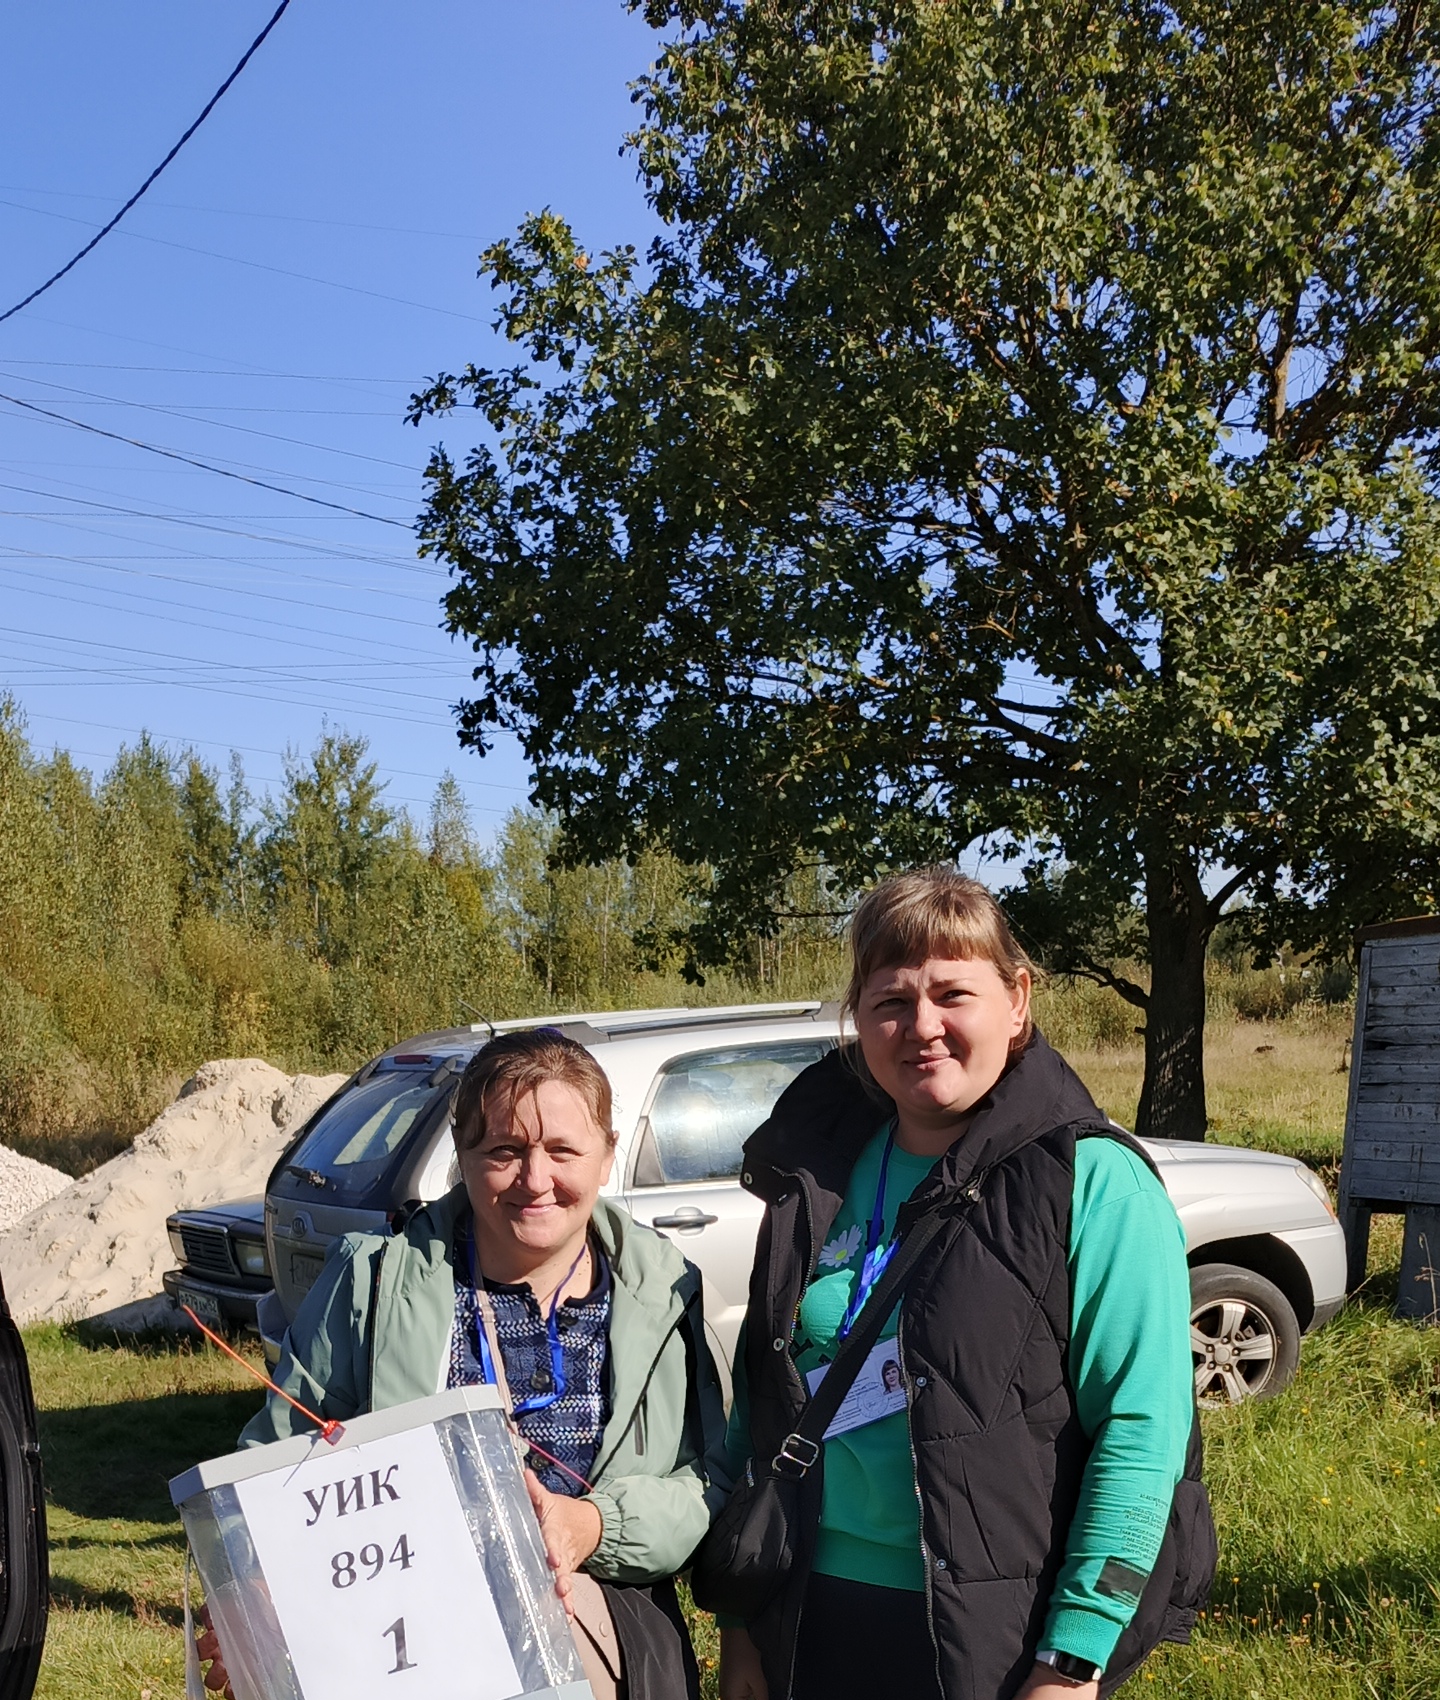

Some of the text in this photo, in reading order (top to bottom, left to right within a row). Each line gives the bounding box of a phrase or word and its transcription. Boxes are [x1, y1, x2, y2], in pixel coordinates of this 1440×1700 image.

[303, 1464, 401, 1526] УИК
[331, 1533, 415, 1589] 894
[382, 1617, 418, 1675] 1
